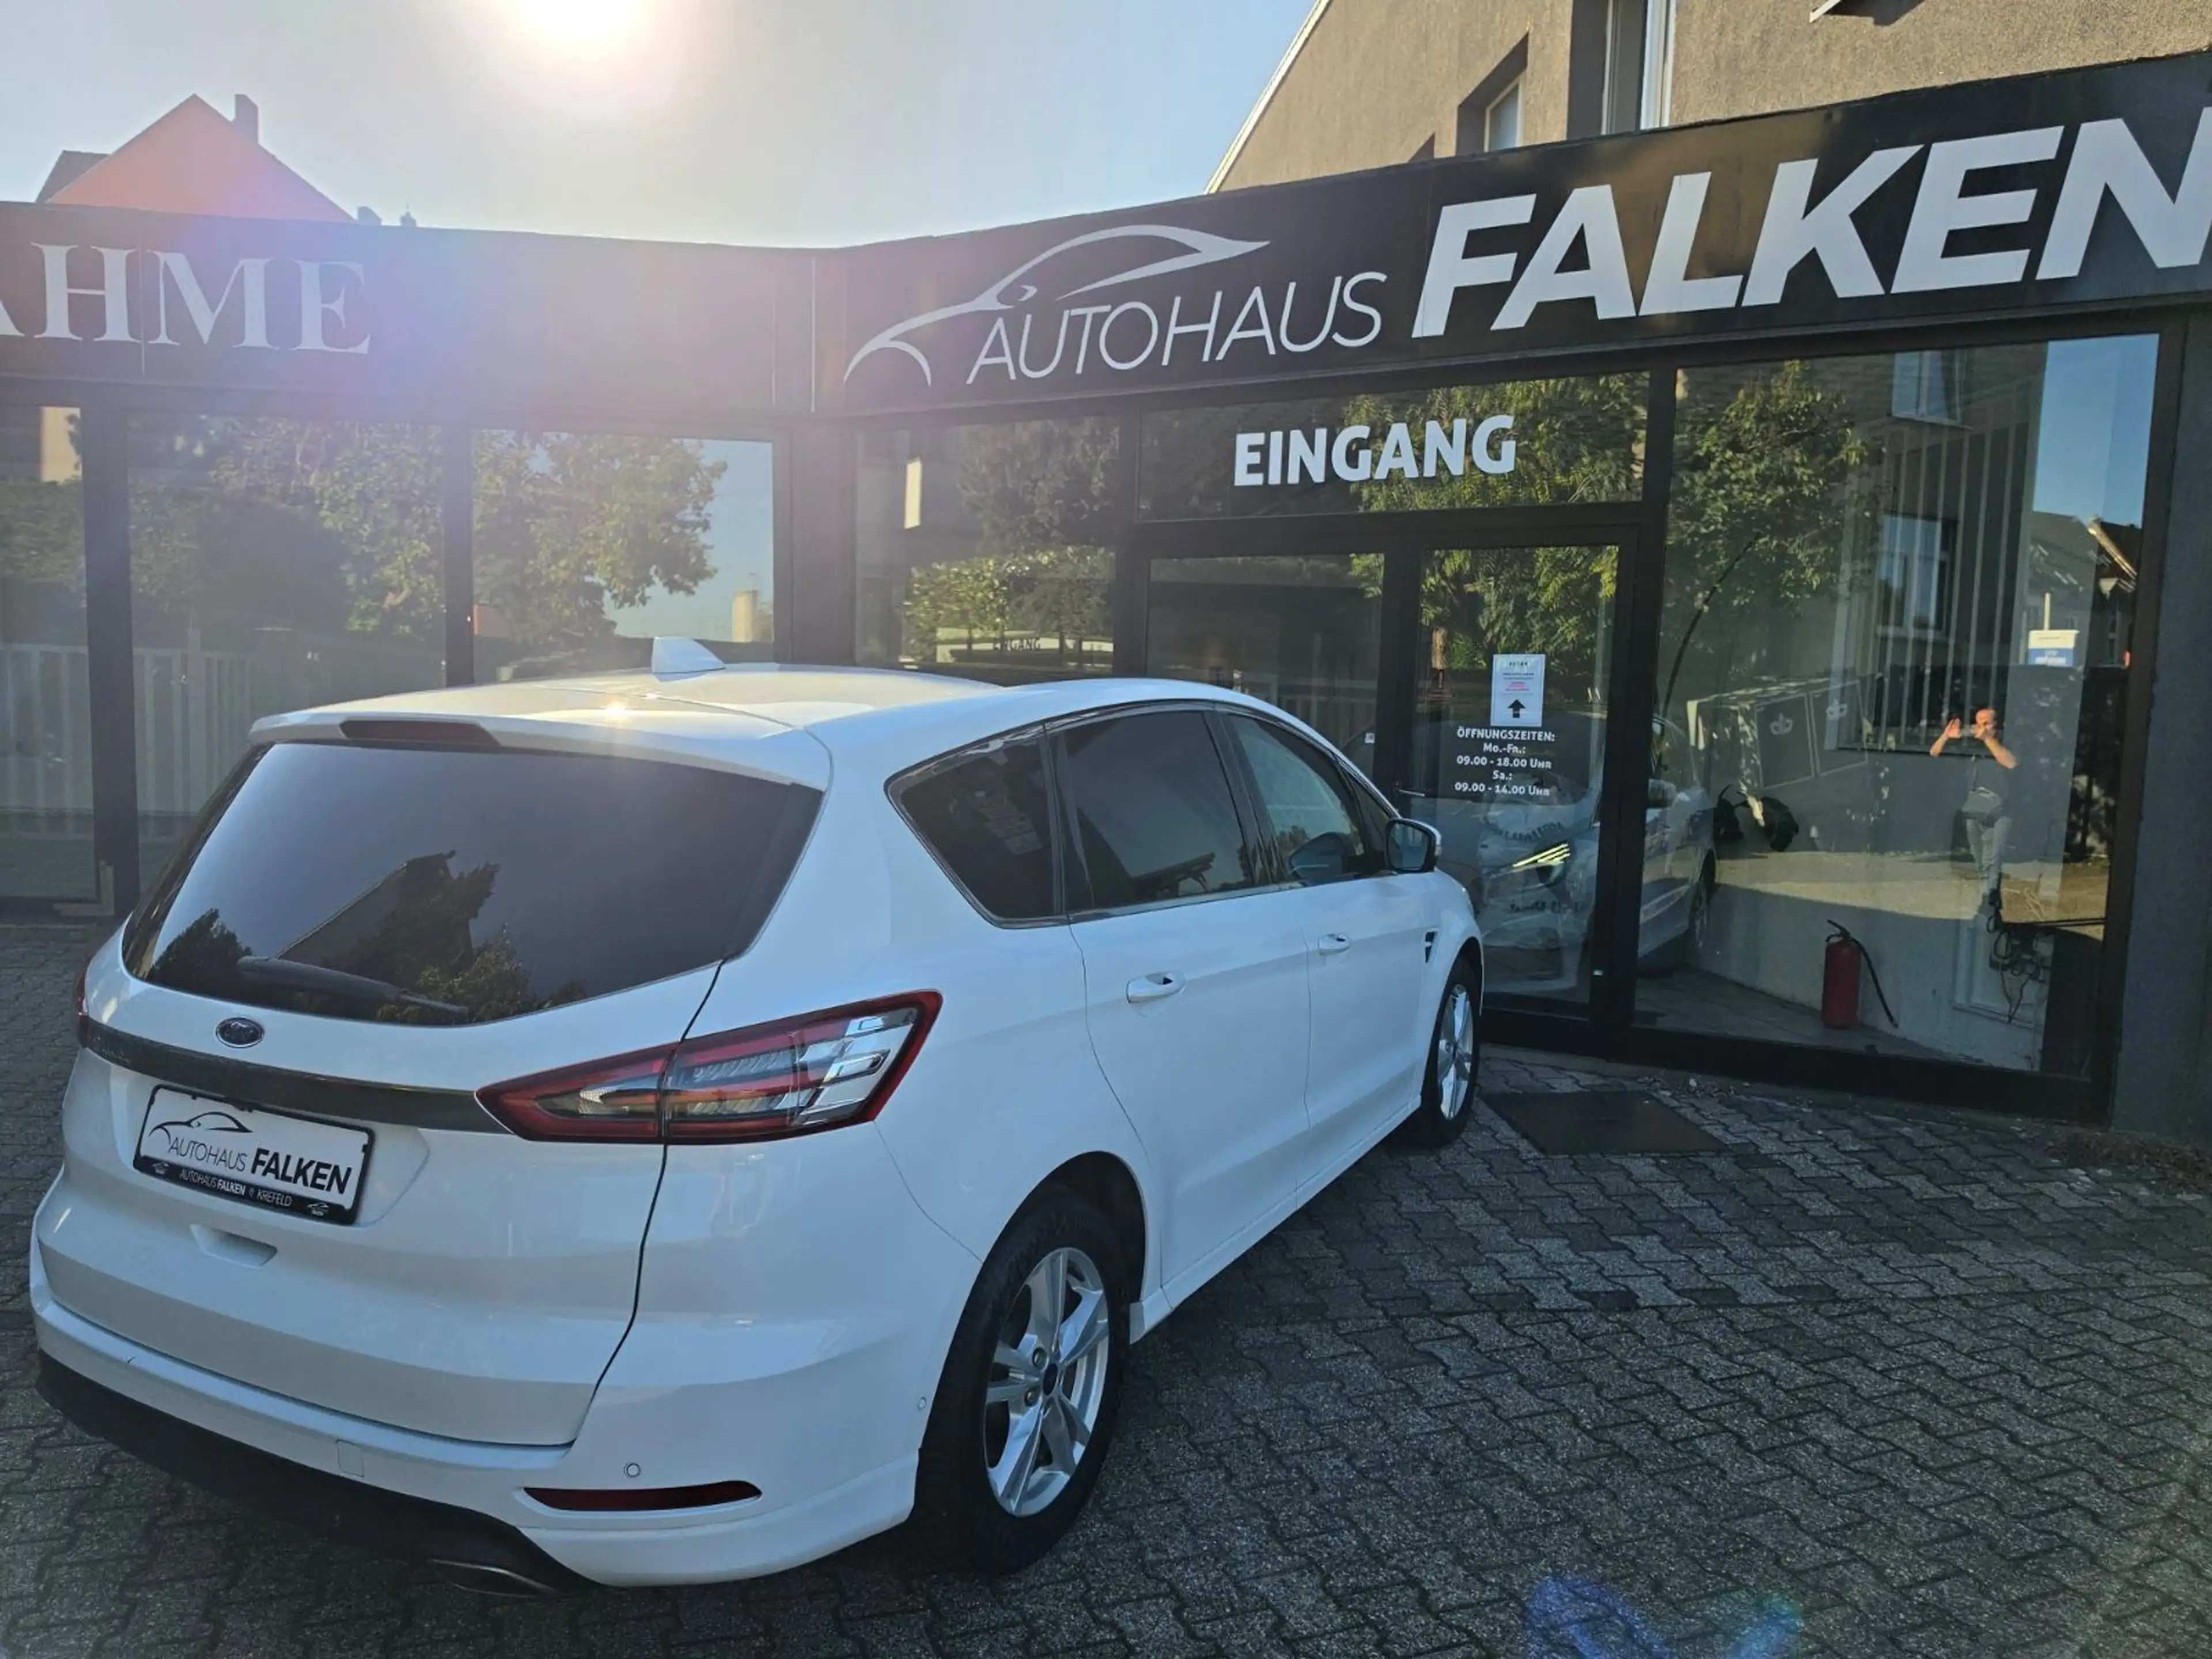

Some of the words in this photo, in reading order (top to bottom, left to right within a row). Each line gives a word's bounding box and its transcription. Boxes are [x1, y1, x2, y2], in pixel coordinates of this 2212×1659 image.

[966, 271, 1388, 385] AUTOHAUS
[1412, 107, 2212, 338] FALKEN
[0, 243, 372, 354] HME
[1234, 415, 1517, 487] EINGANG
[1456, 726, 1555, 742] ÖFFNUNGSZEITEN:
[1456, 755, 1487, 766] 09.00
[1497, 757, 1527, 767] 18.00
[1455, 782, 1486, 792] 09.00
[1495, 785, 1525, 794] 14.00
[169, 1137, 248, 1172] AUTOHAUS
[250, 1147, 353, 1195] FALKEN
[217, 1179, 246, 1195] FALKEN
[257, 1188, 293, 1207] KREFELD
